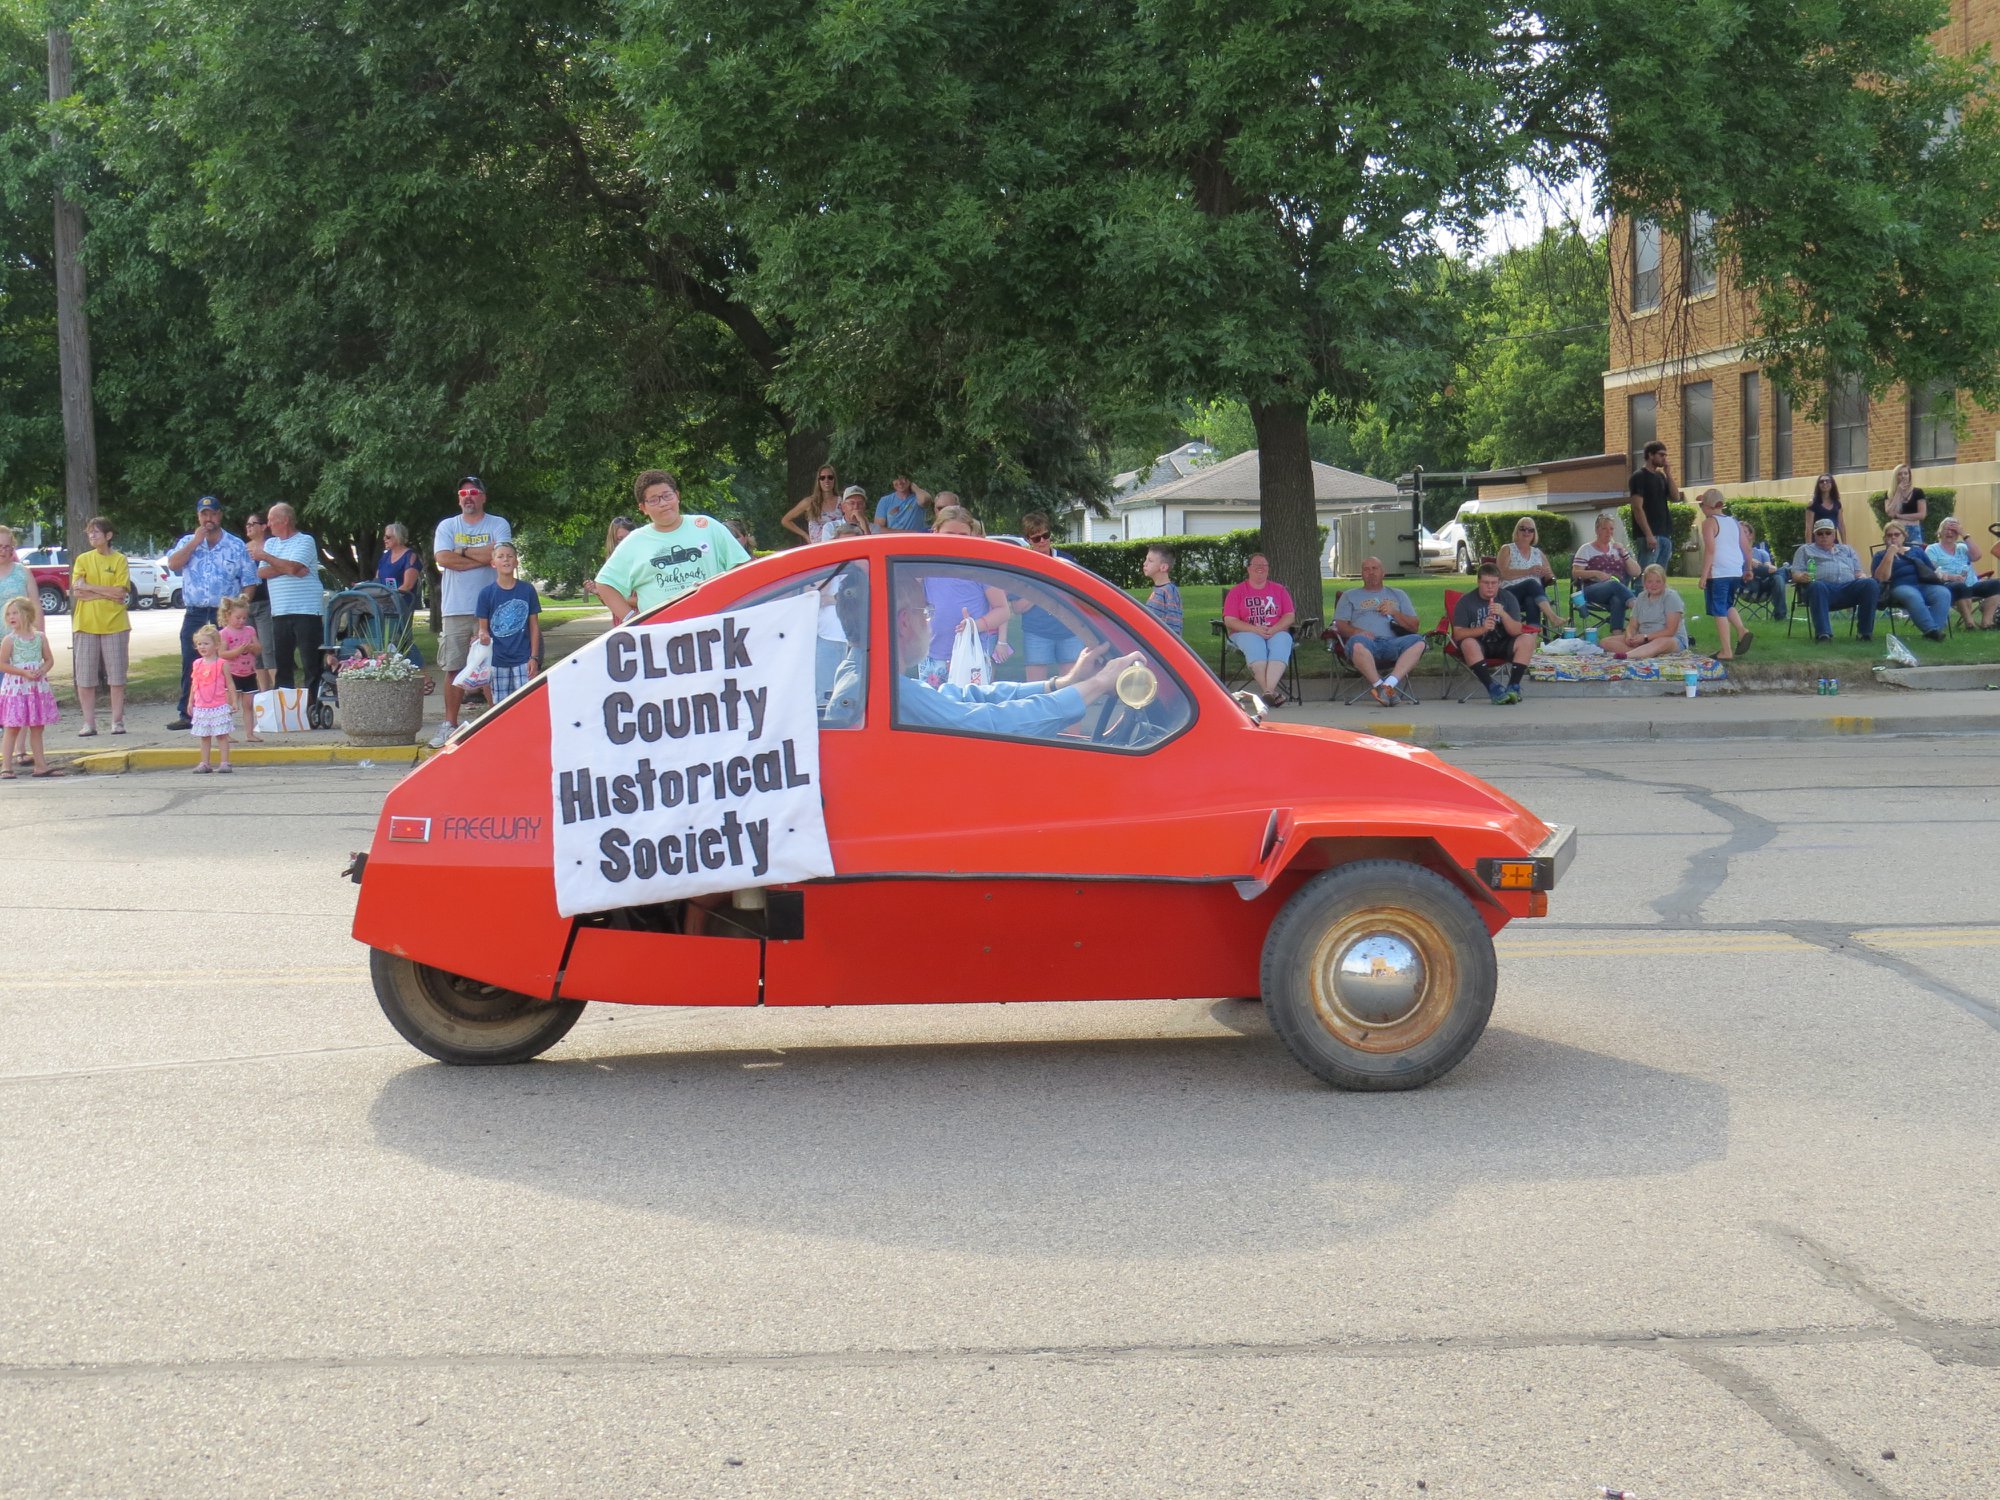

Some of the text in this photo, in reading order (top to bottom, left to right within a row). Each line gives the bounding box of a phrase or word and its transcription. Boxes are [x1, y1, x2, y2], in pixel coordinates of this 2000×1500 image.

[656, 567, 706, 588] Backroads
[602, 678, 768, 745] County
[443, 816, 542, 840] FREEWAY
[599, 810, 770, 883] Society
